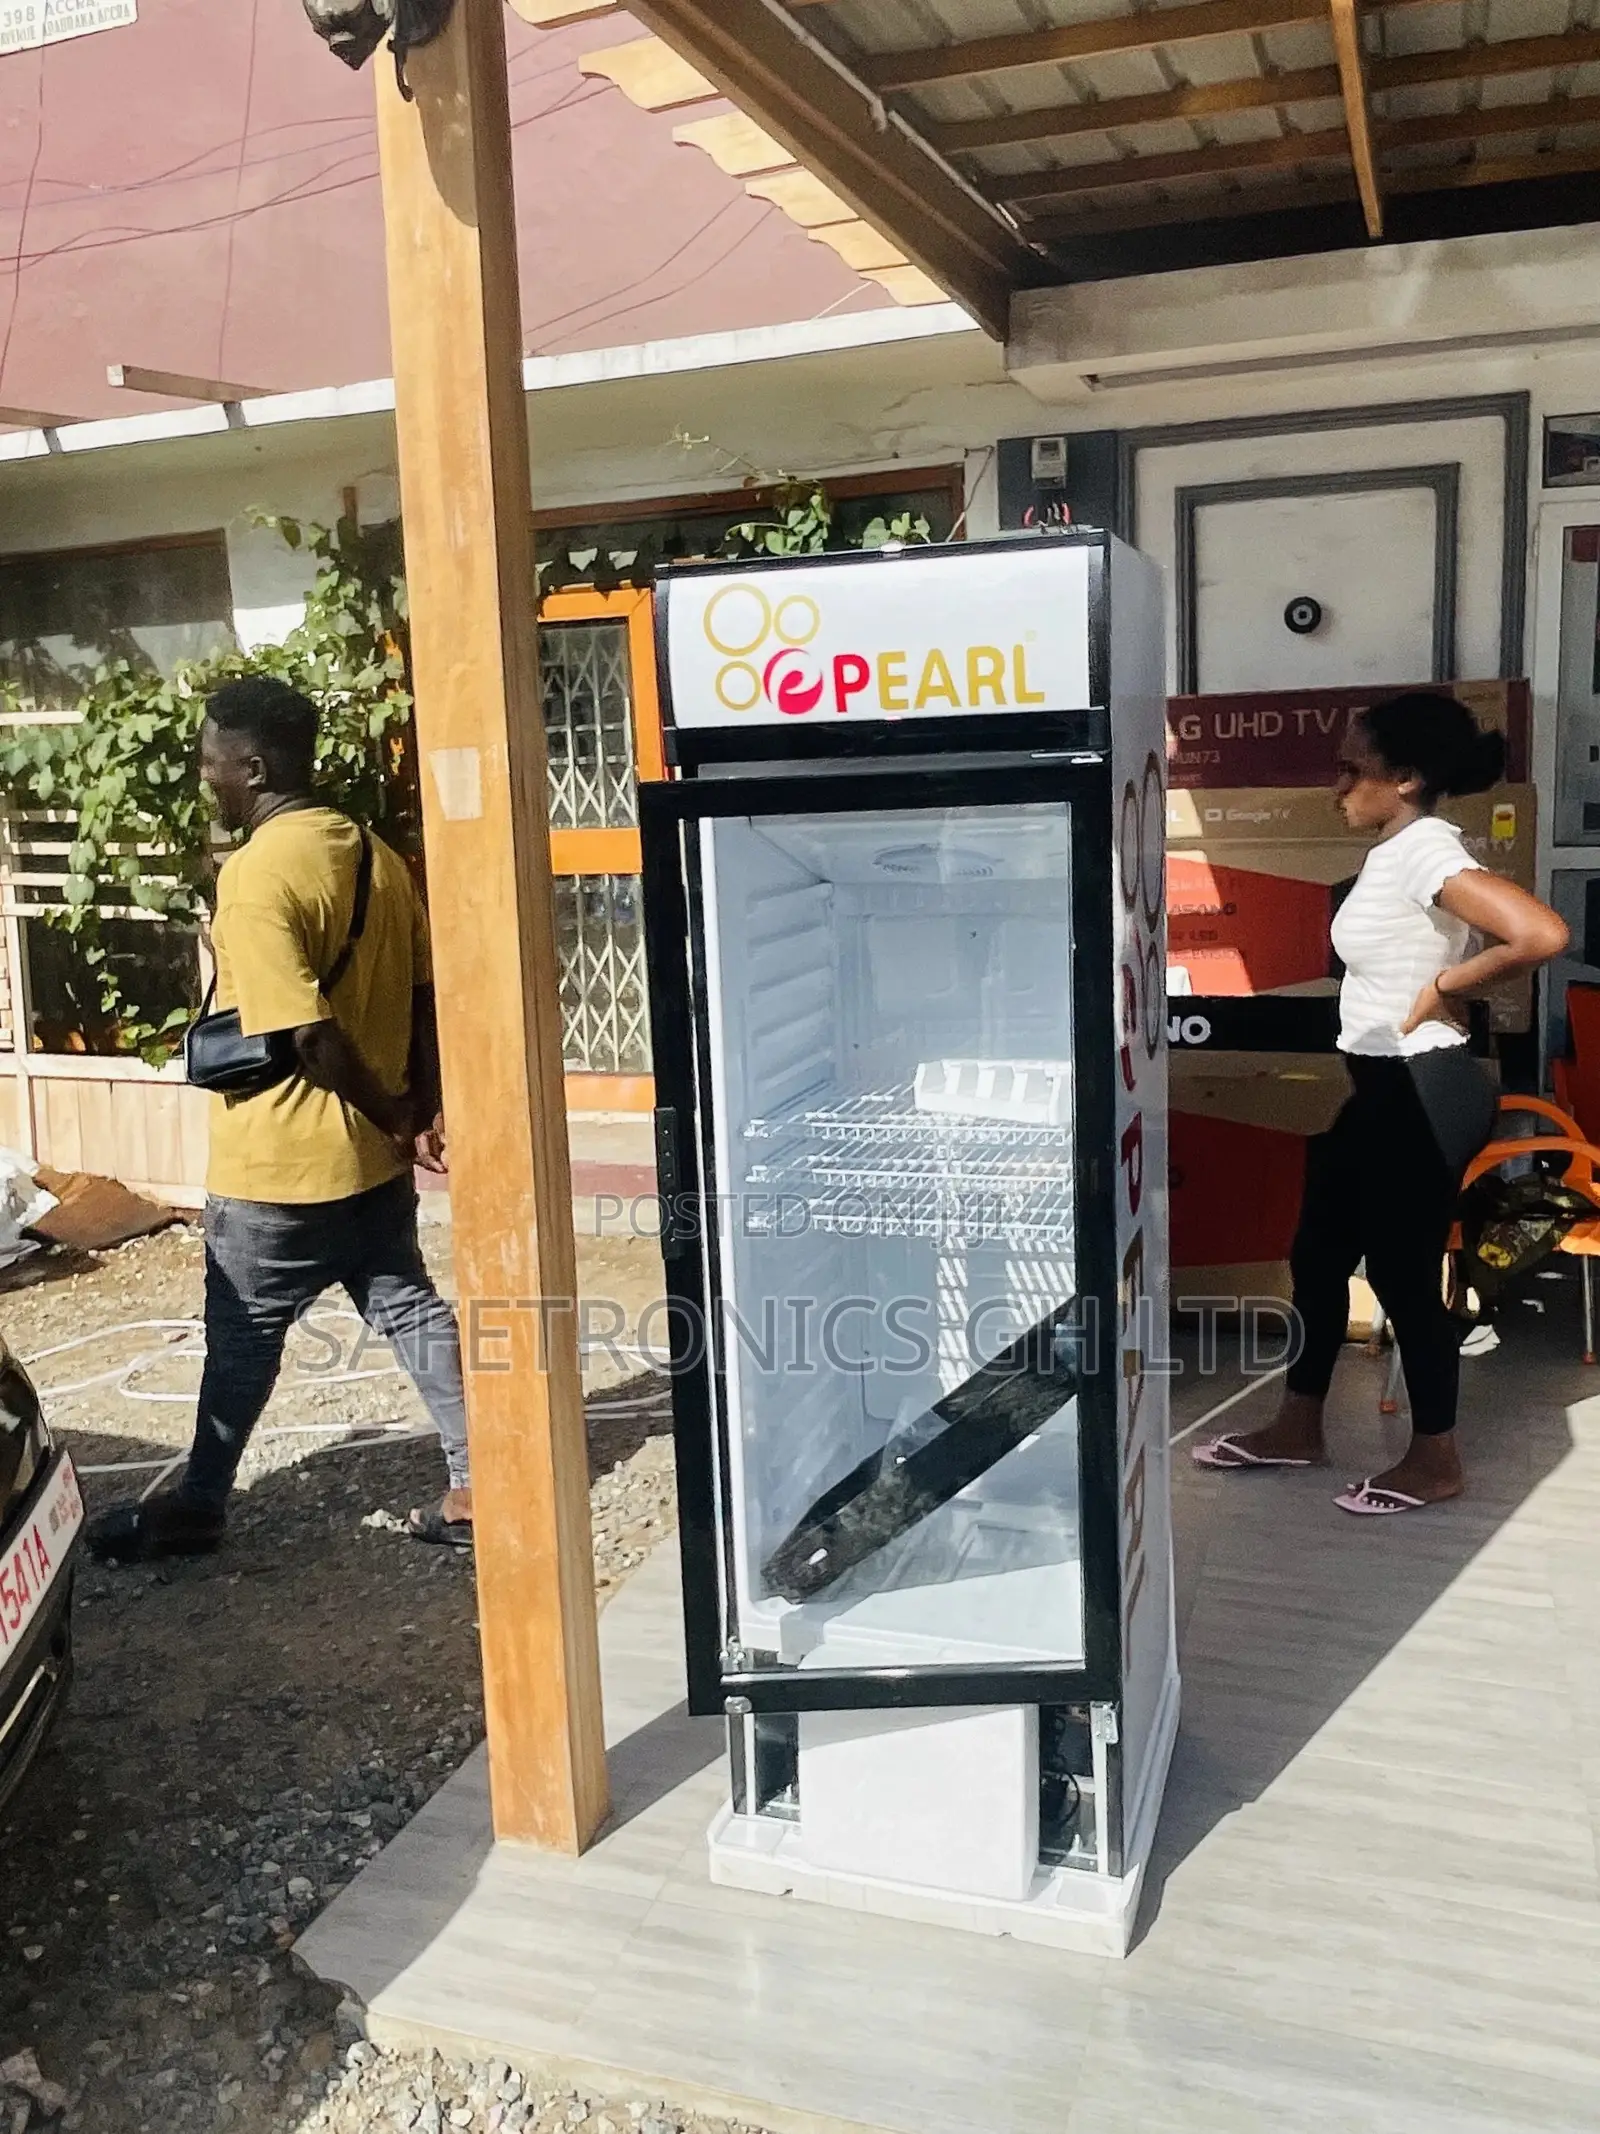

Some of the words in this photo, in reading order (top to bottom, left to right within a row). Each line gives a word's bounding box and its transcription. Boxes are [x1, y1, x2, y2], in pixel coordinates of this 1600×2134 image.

[832, 643, 1045, 713] PEARL
[1214, 711, 1283, 739] UHD
[1292, 707, 1338, 738] TV
